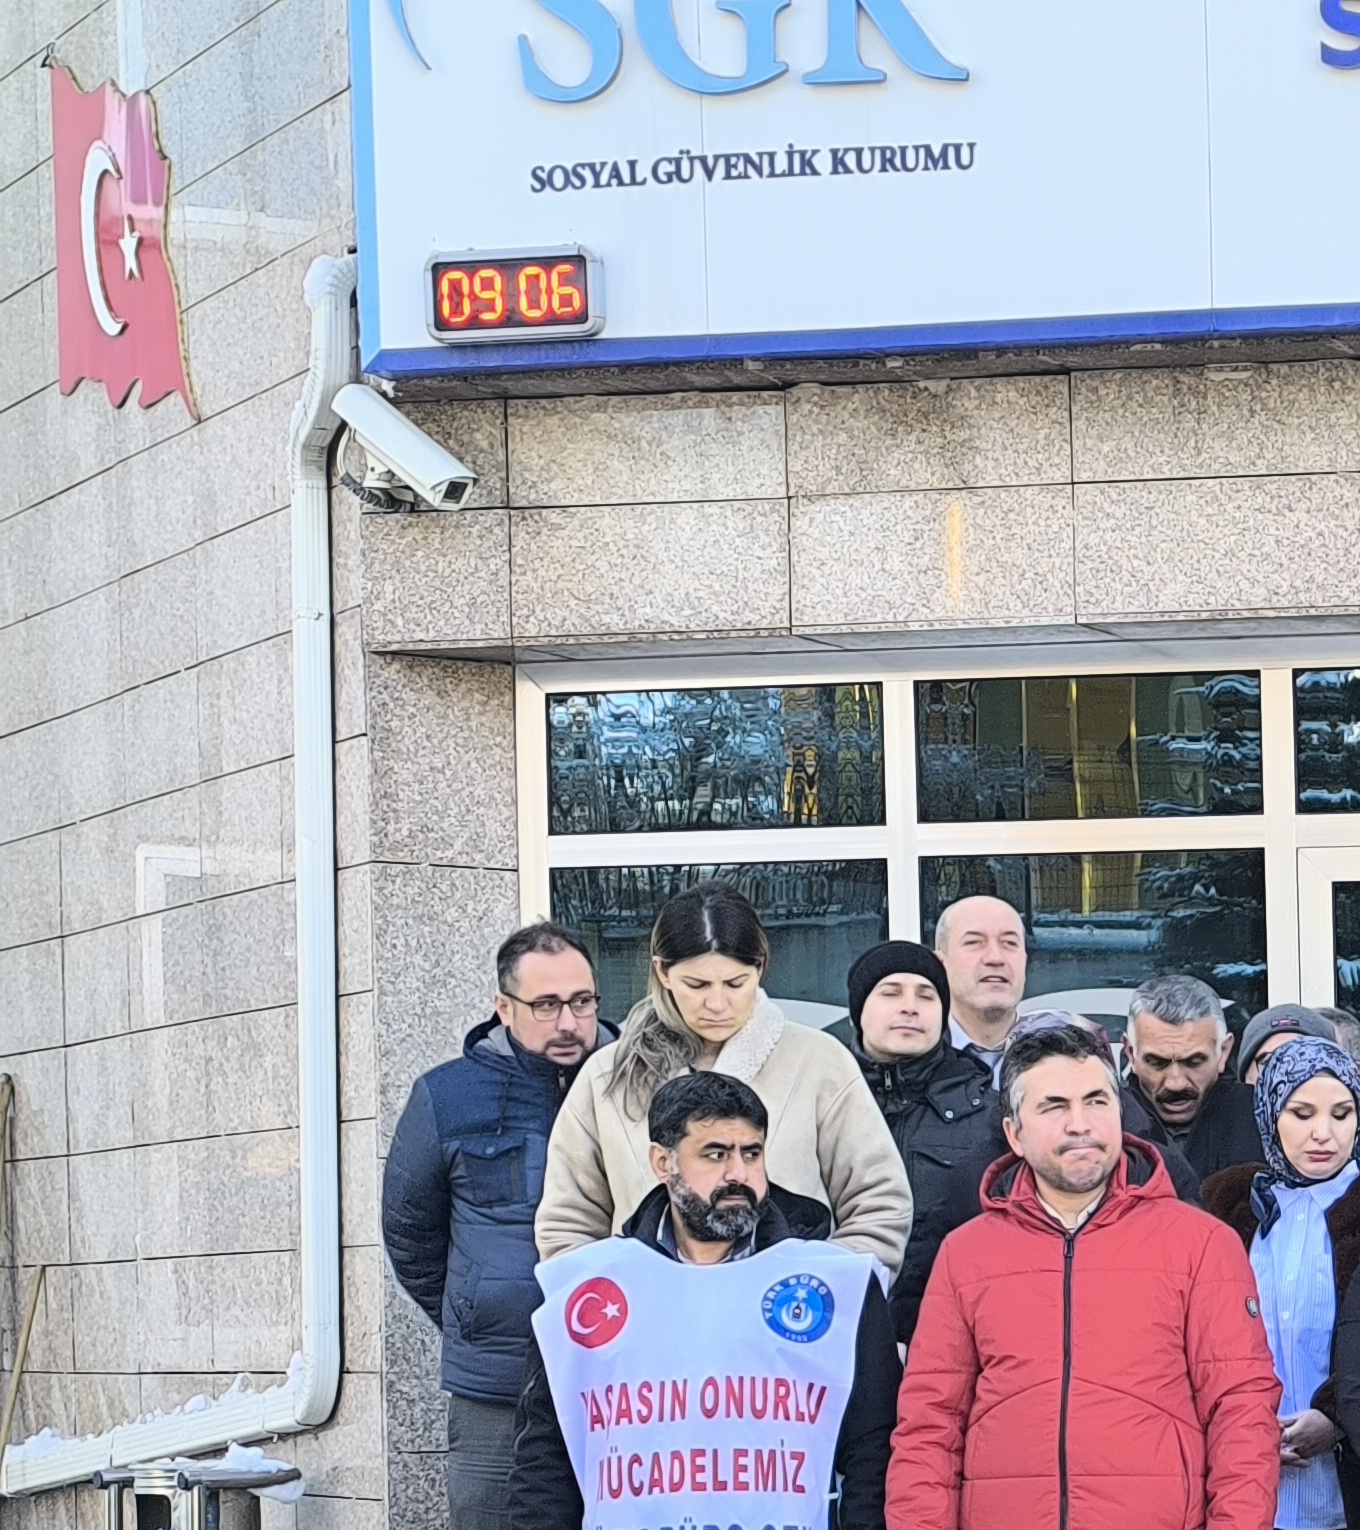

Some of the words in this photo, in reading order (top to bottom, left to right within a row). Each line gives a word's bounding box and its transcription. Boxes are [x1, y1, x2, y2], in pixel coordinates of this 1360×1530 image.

[530, 156, 647, 193] SOSYAL
[651, 142, 823, 183] GÜVENLİK
[829, 142, 977, 176] KURUMU
[699, 1375, 828, 1425] ONURLU
